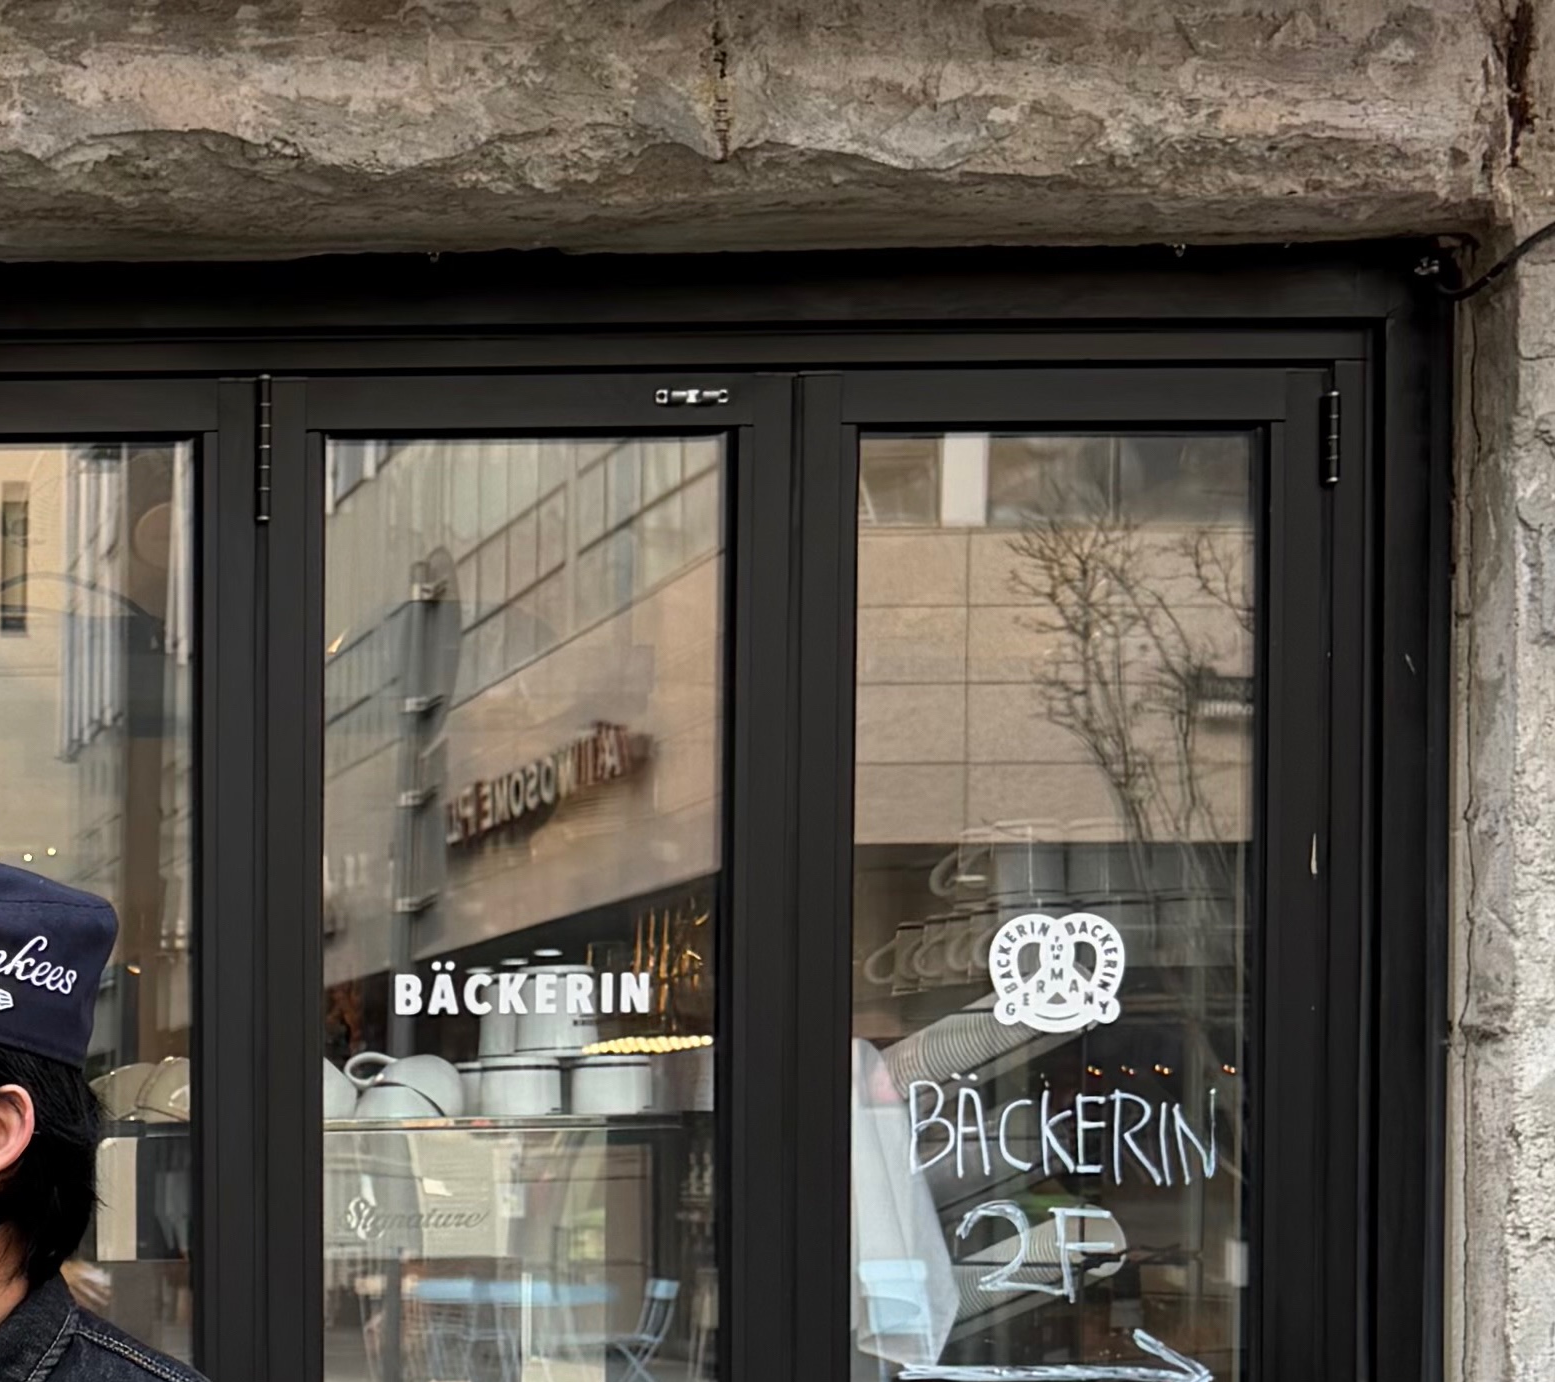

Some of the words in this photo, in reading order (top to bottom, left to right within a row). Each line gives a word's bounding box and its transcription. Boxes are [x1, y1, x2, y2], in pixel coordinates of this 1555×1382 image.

[395, 961, 650, 1015] BÄCKERIN
[1005, 968, 1110, 1015] GERMANY
[346, 1196, 490, 1240] Signature
[956, 1200, 1115, 1304] 2F
